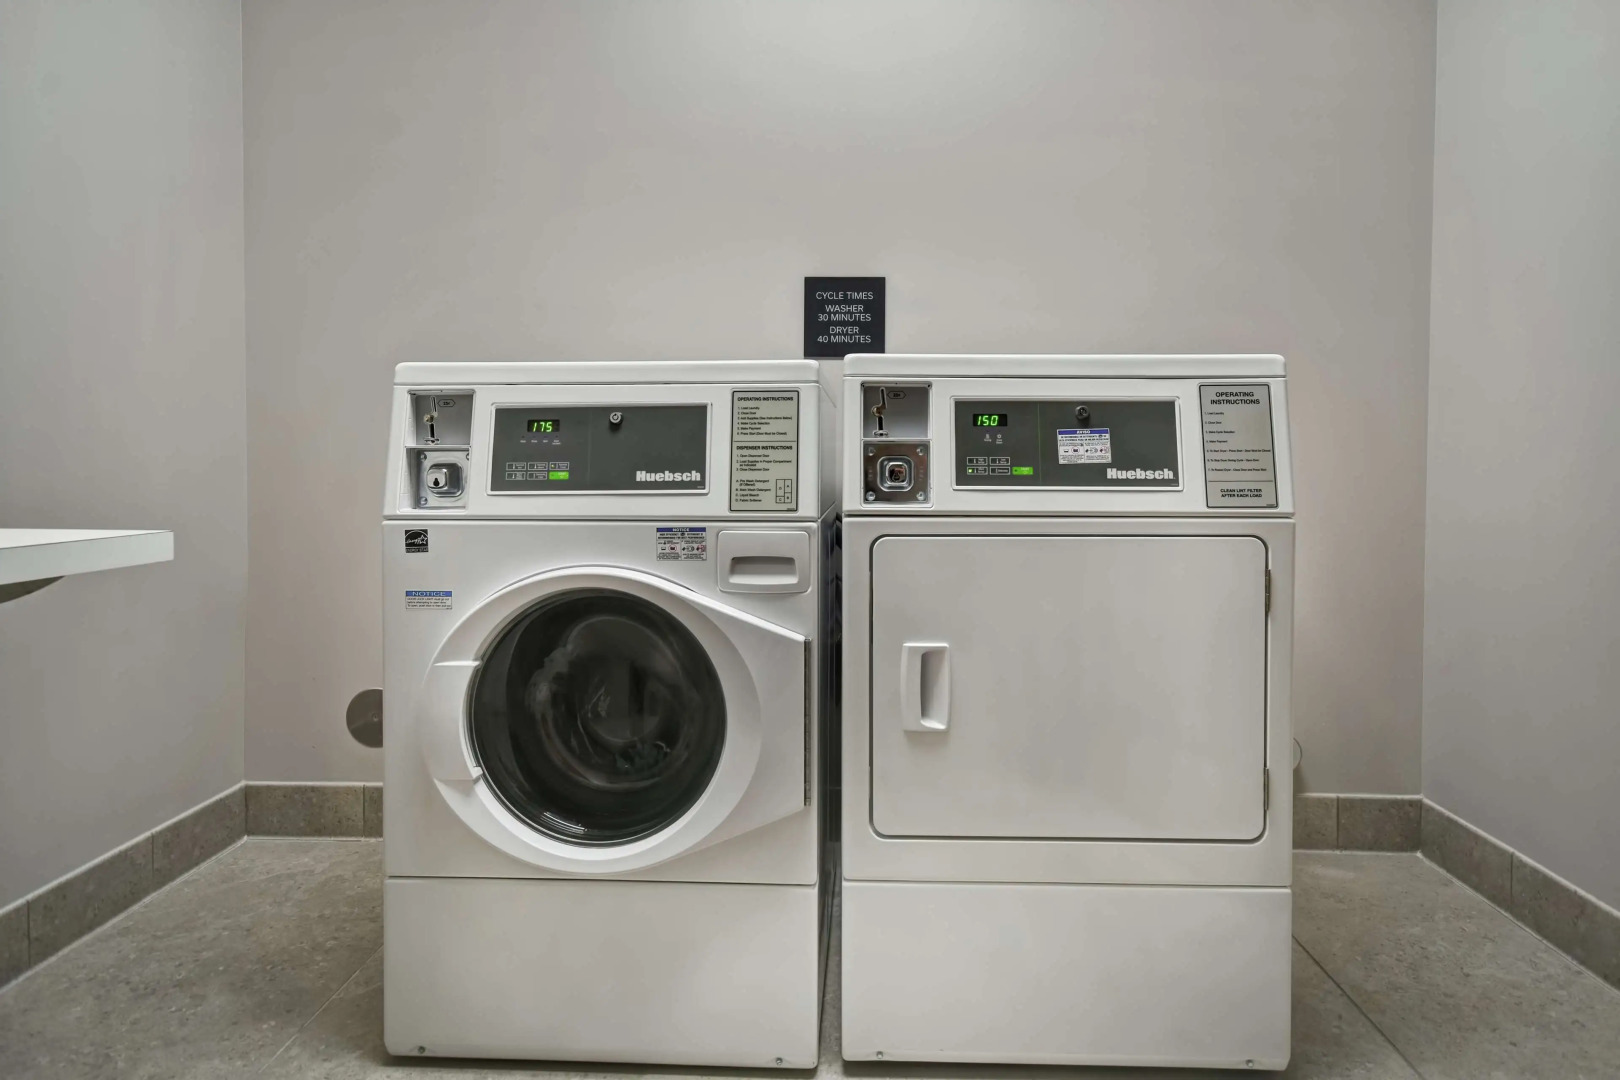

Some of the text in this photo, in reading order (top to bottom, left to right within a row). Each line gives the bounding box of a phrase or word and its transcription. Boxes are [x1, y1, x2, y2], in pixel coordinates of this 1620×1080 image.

[816, 291, 874, 300] CYCLE TIMES
[825, 304, 864, 313] WASHER
[818, 313, 872, 322] 30 MINUTES
[829, 326, 860, 334] DRYER
[817, 335, 872, 343] 40 MINUTES
[977, 415, 999, 426] 150
[532, 421, 553, 433] 175
[635, 470, 701, 482] Huebsch
[1106, 467, 1174, 480] Huebsch
